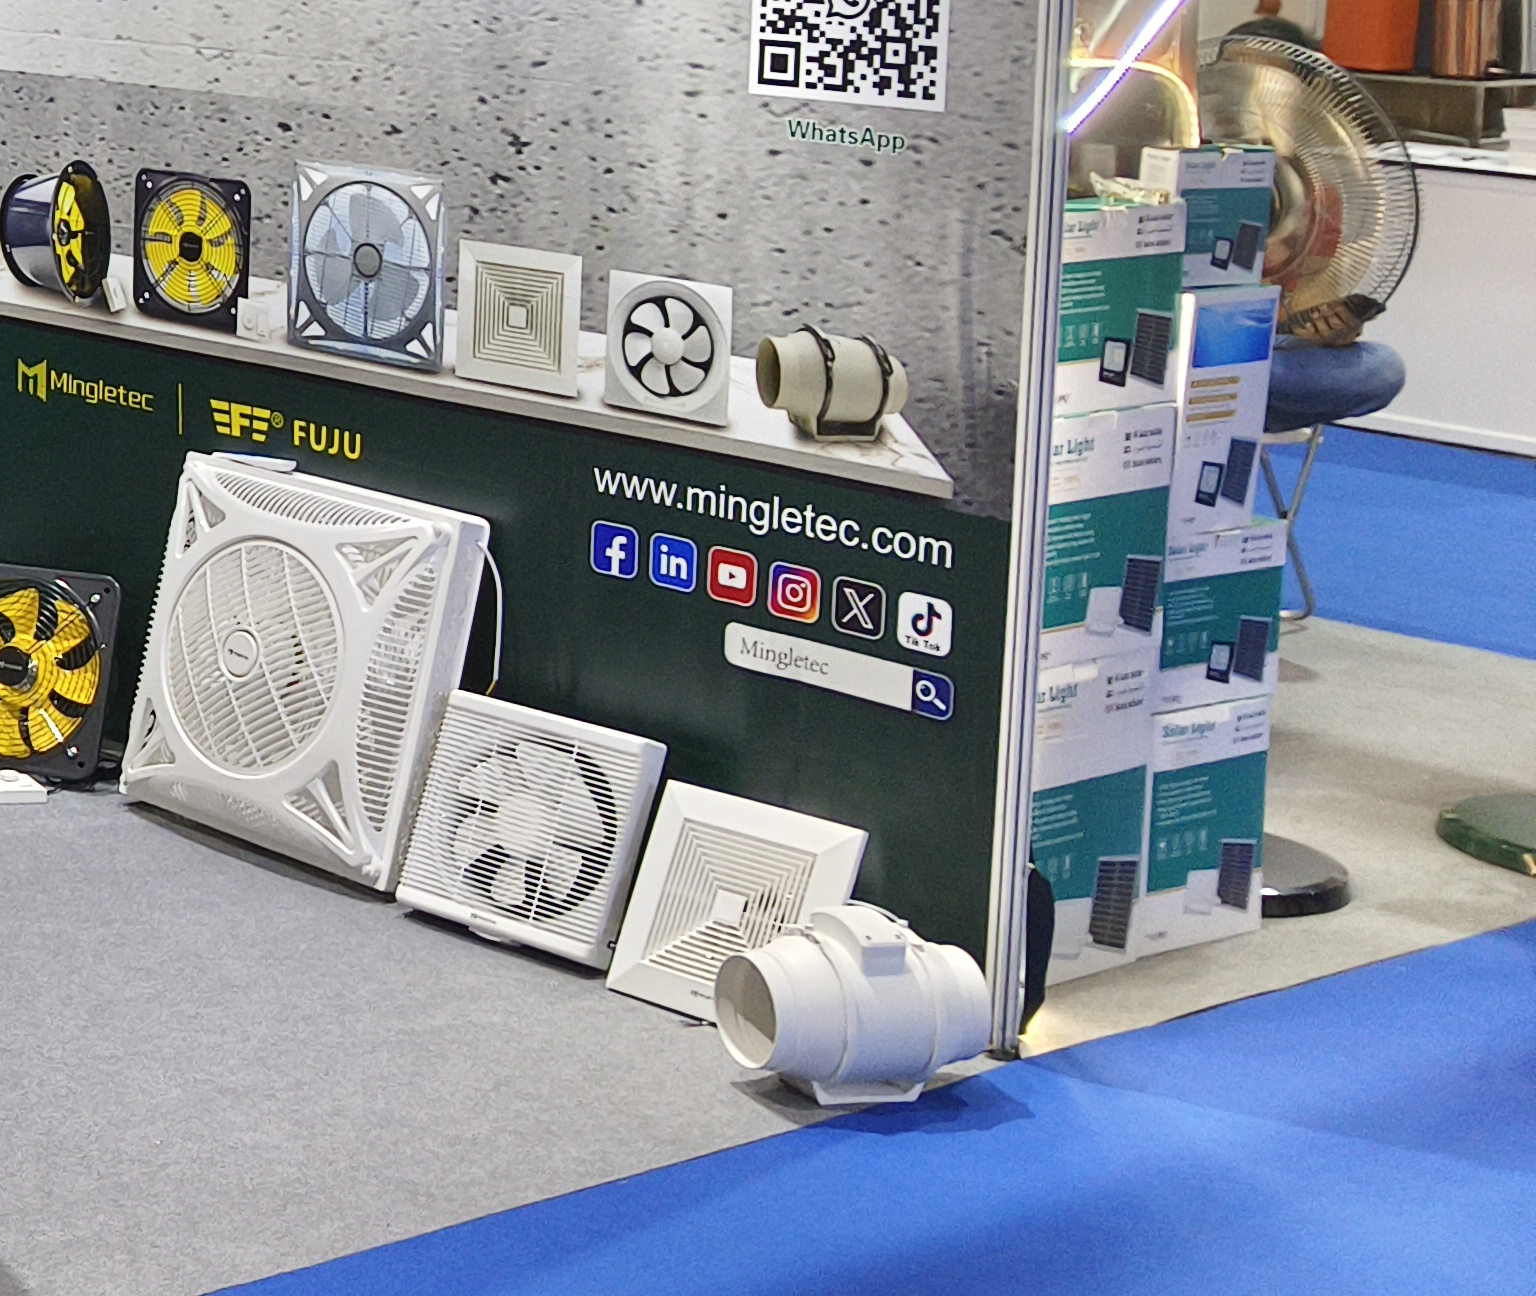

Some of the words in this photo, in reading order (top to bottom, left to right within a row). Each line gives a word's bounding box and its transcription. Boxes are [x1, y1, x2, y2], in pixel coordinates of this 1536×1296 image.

[788, 119, 907, 155] WhatsApp
[50, 371, 154, 413] Mingletec
[292, 420, 362, 461] FUJU
[593, 466, 953, 569] www.mingletec.com
[740, 636, 830, 676] Mingletec
